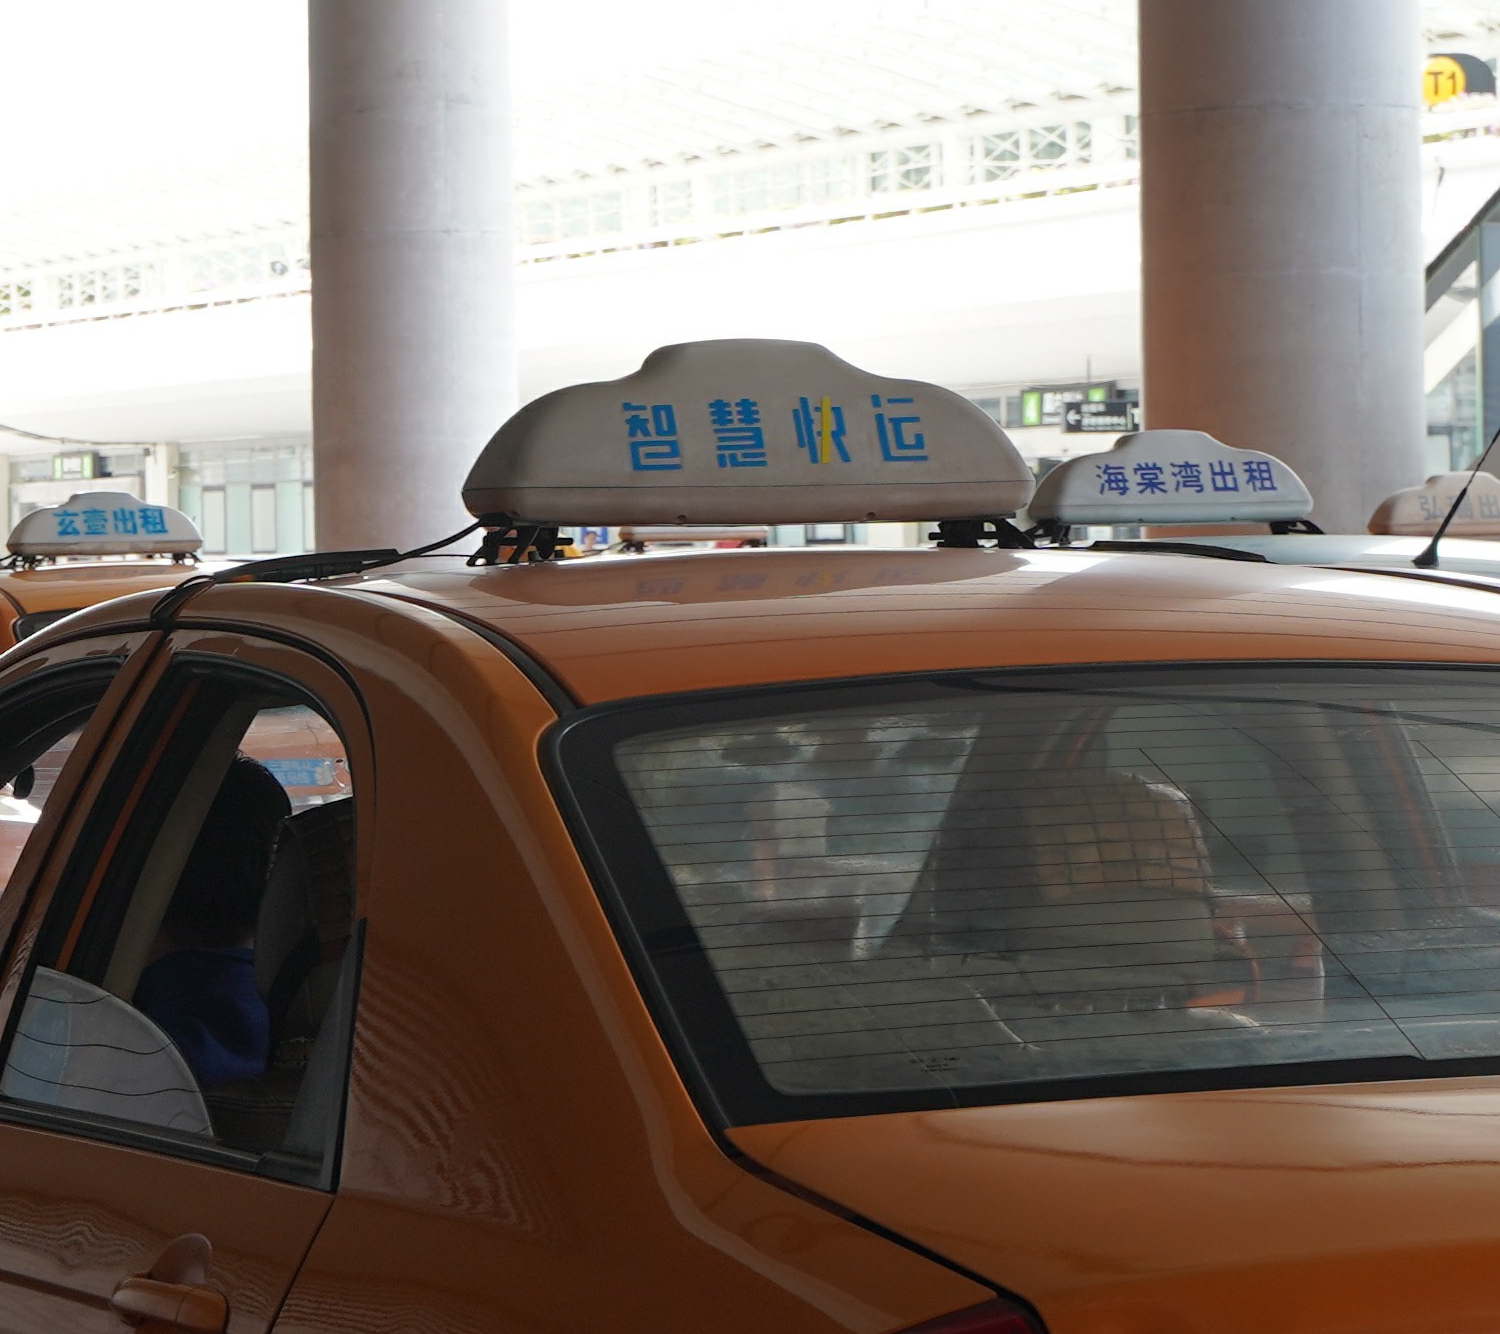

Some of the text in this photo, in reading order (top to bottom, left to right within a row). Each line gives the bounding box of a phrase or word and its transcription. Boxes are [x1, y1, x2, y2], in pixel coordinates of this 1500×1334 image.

[1426, 70, 1457, 97] T1
[622, 394, 930, 471] 智慧快运
[1095, 460, 1278, 496] 海棠湾出租
